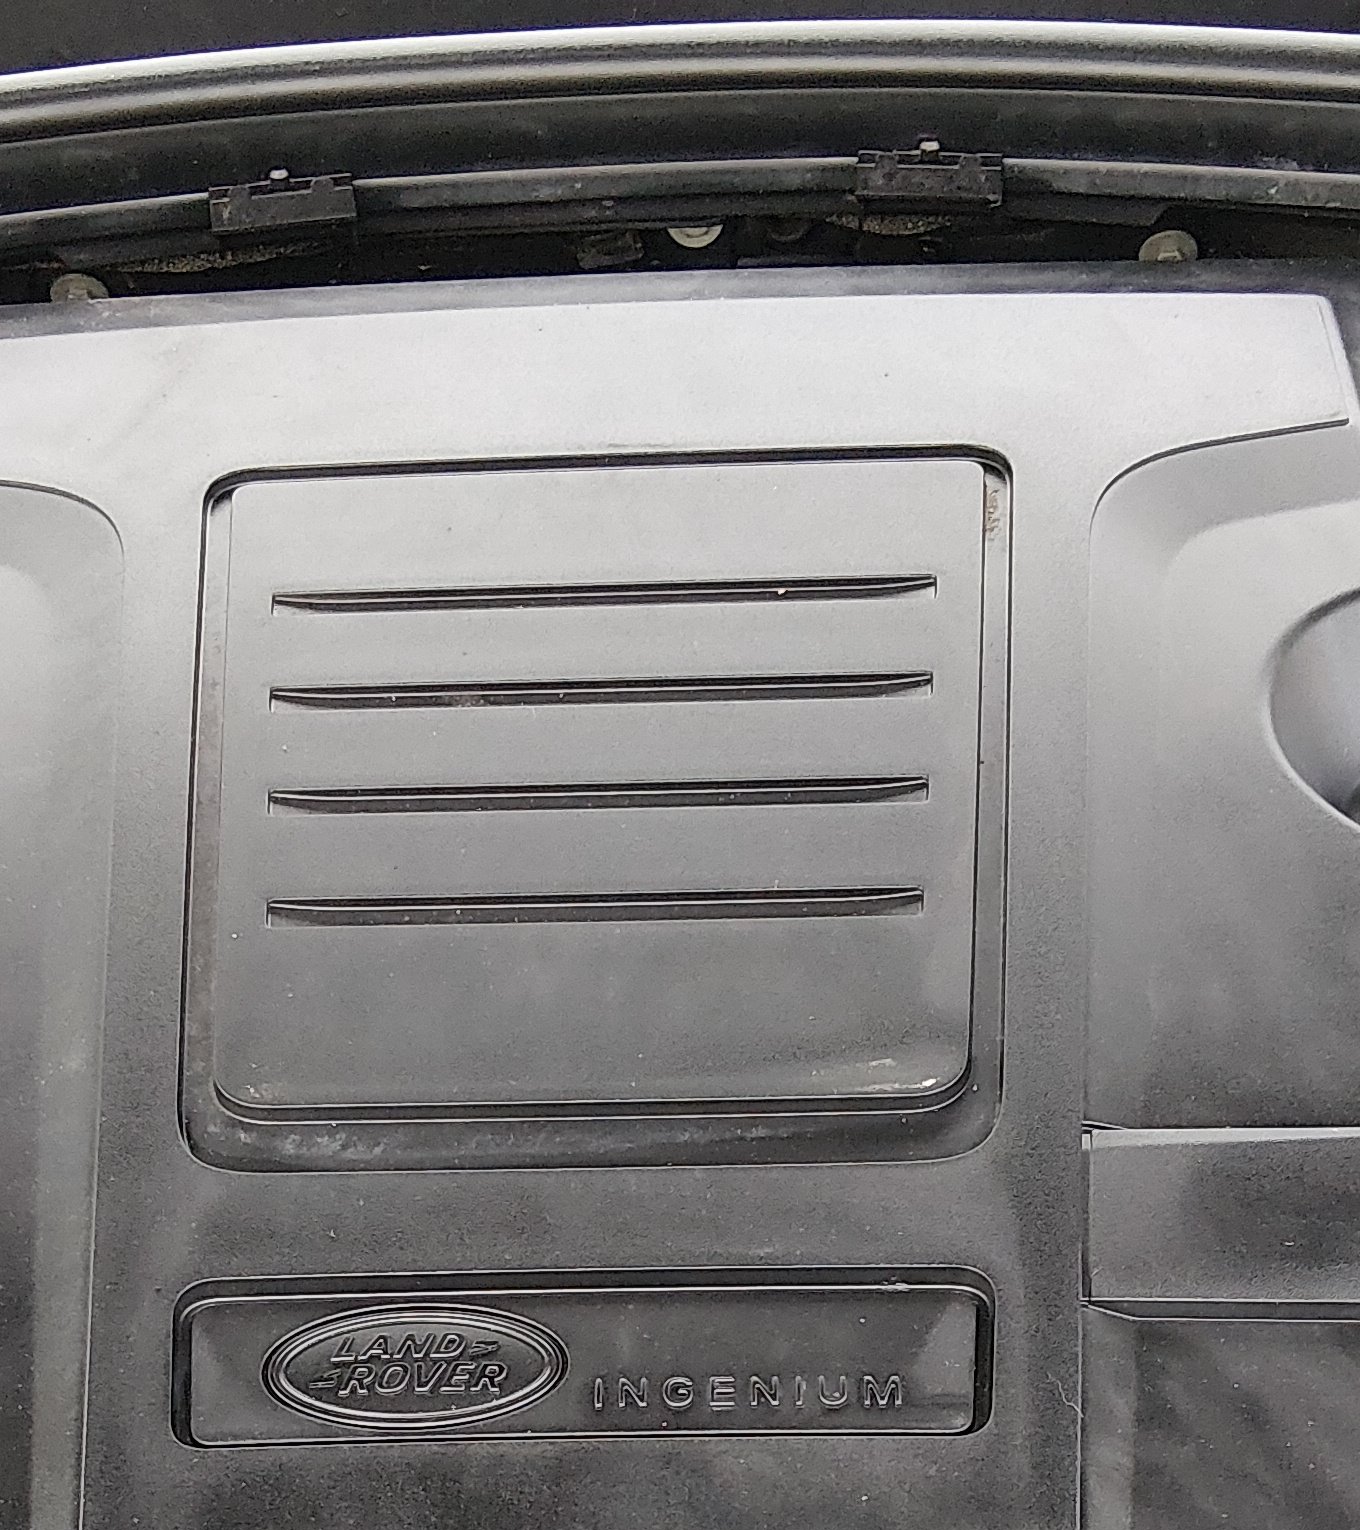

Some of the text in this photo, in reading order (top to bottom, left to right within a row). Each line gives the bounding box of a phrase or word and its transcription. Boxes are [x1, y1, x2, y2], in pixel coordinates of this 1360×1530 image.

[330, 1332, 465, 1362] LAND
[336, 1361, 510, 1396] ROVER
[593, 1374, 907, 1412] INGENIUM
